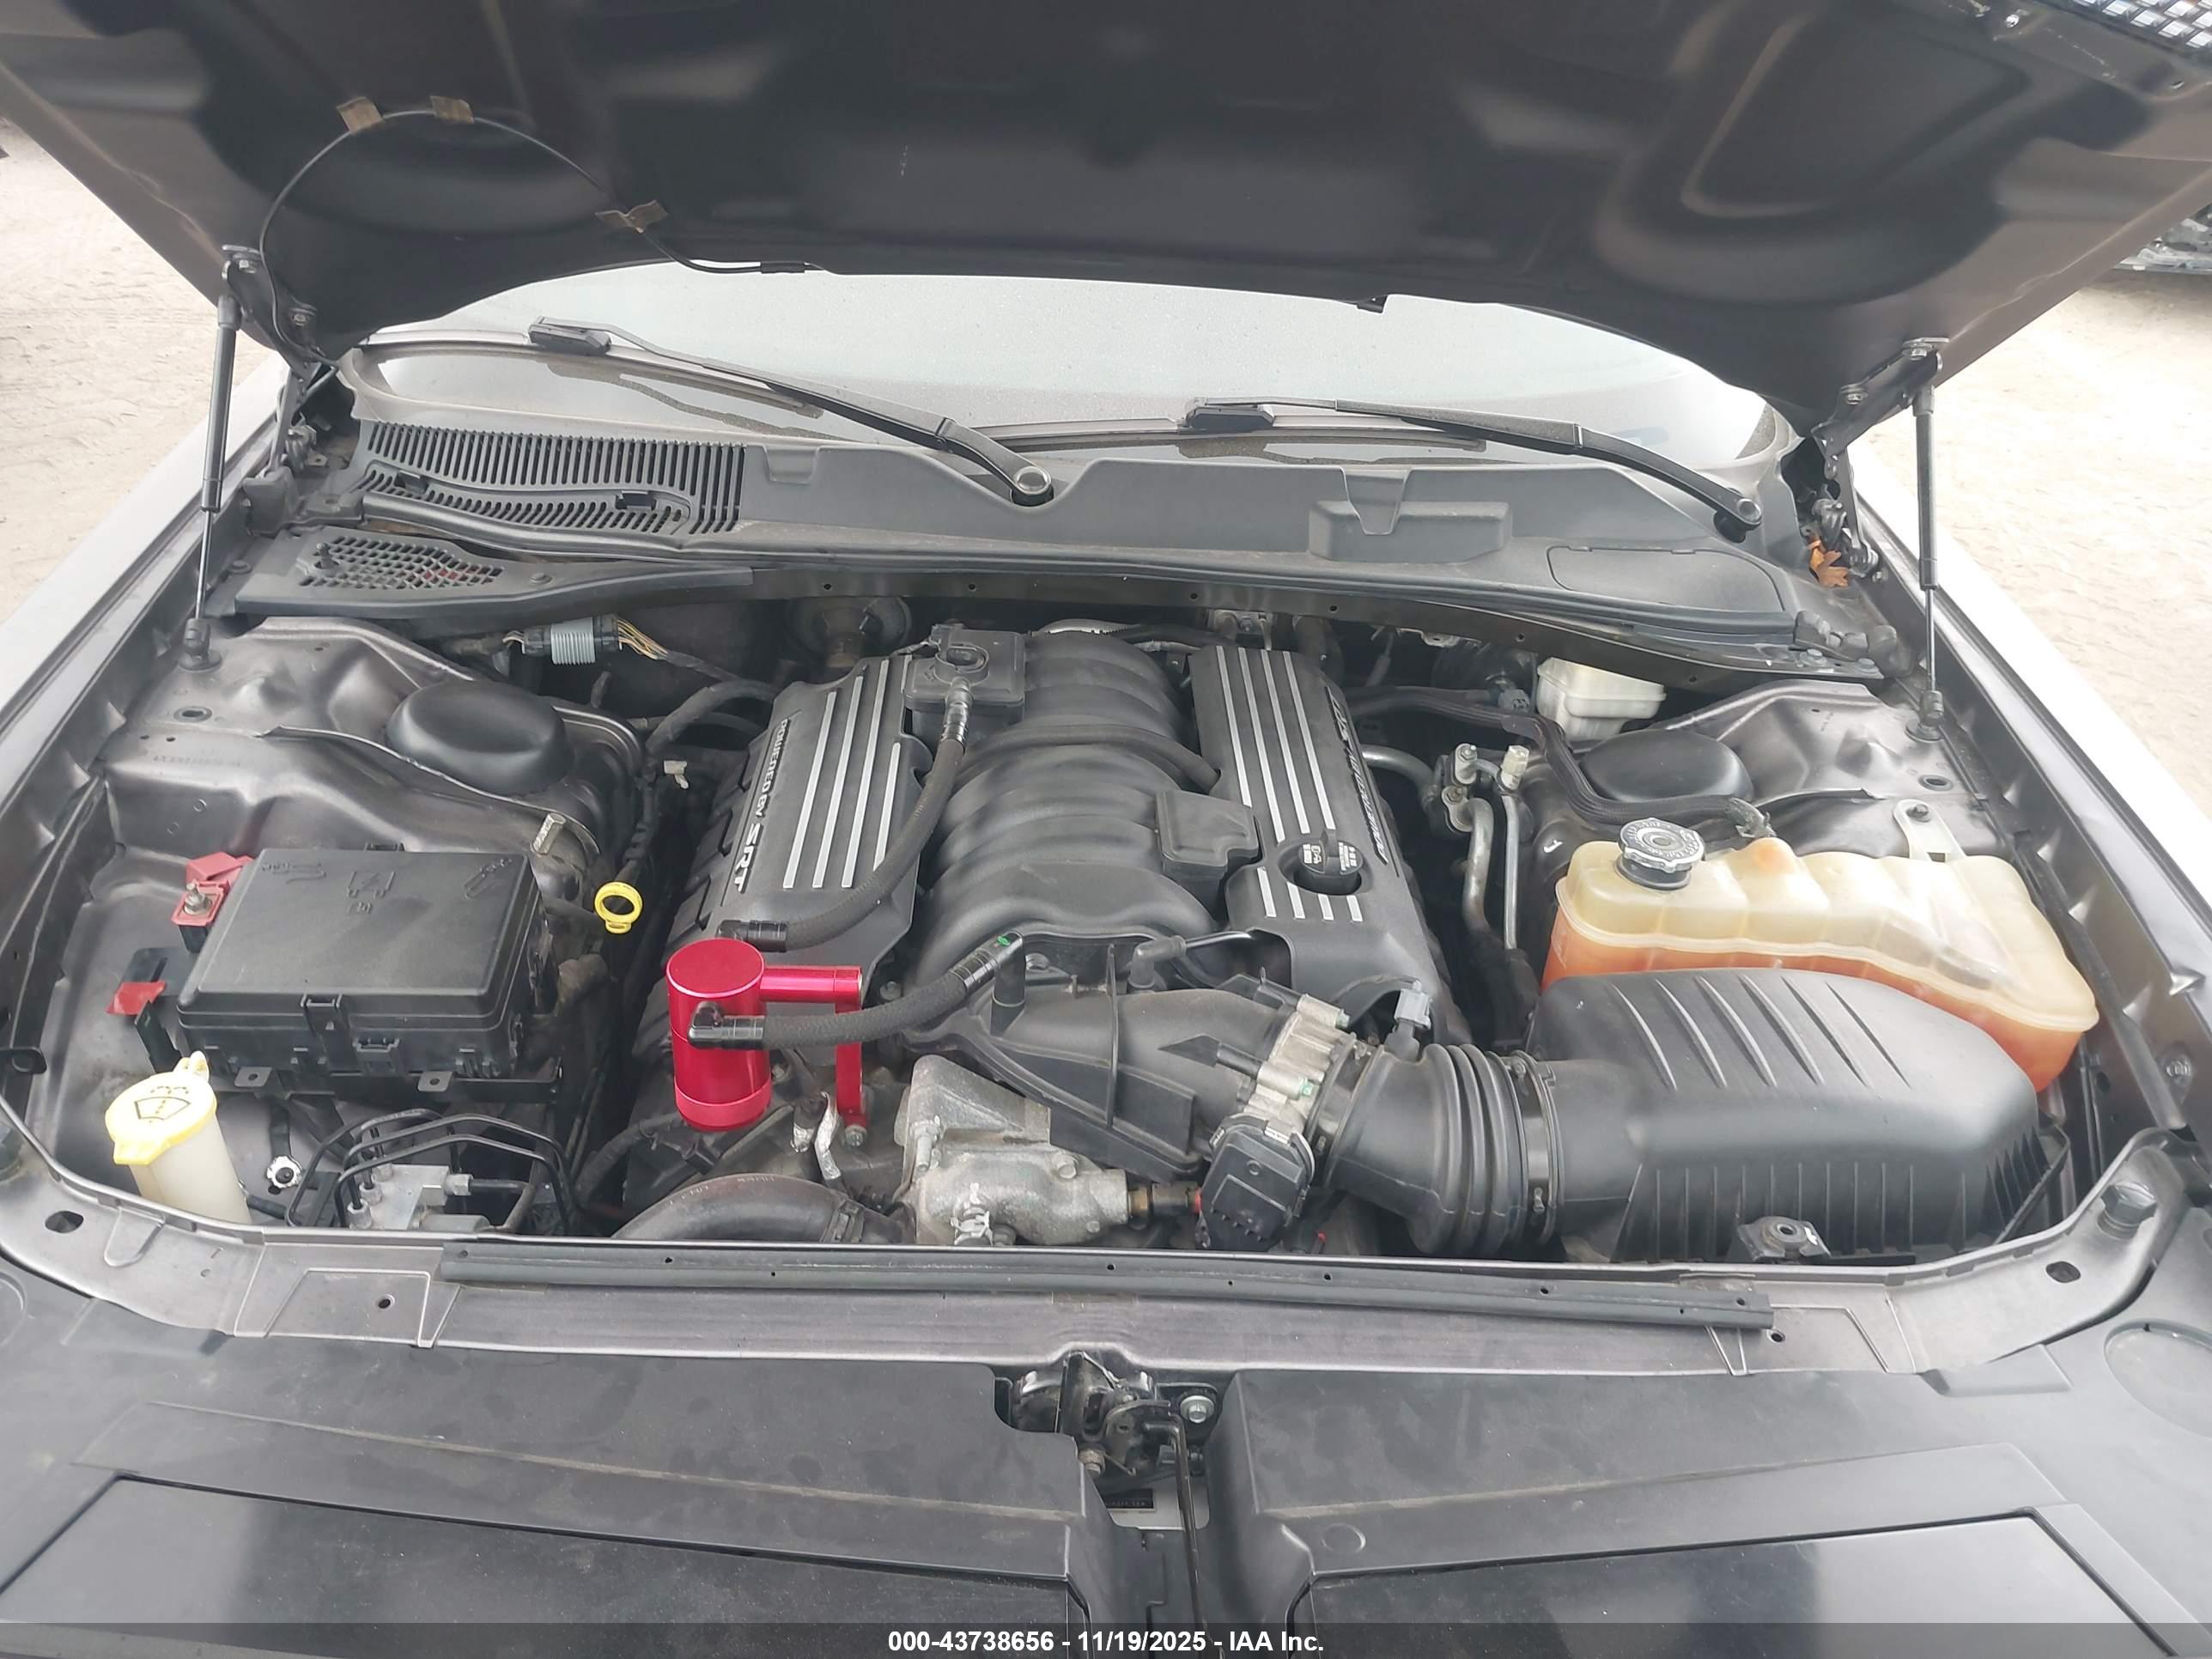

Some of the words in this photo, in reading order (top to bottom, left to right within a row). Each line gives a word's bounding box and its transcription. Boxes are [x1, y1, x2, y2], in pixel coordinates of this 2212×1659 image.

[762, 718, 788, 793] POWERED
[755, 793, 768, 817] BY
[734, 822, 761, 892] SRT
